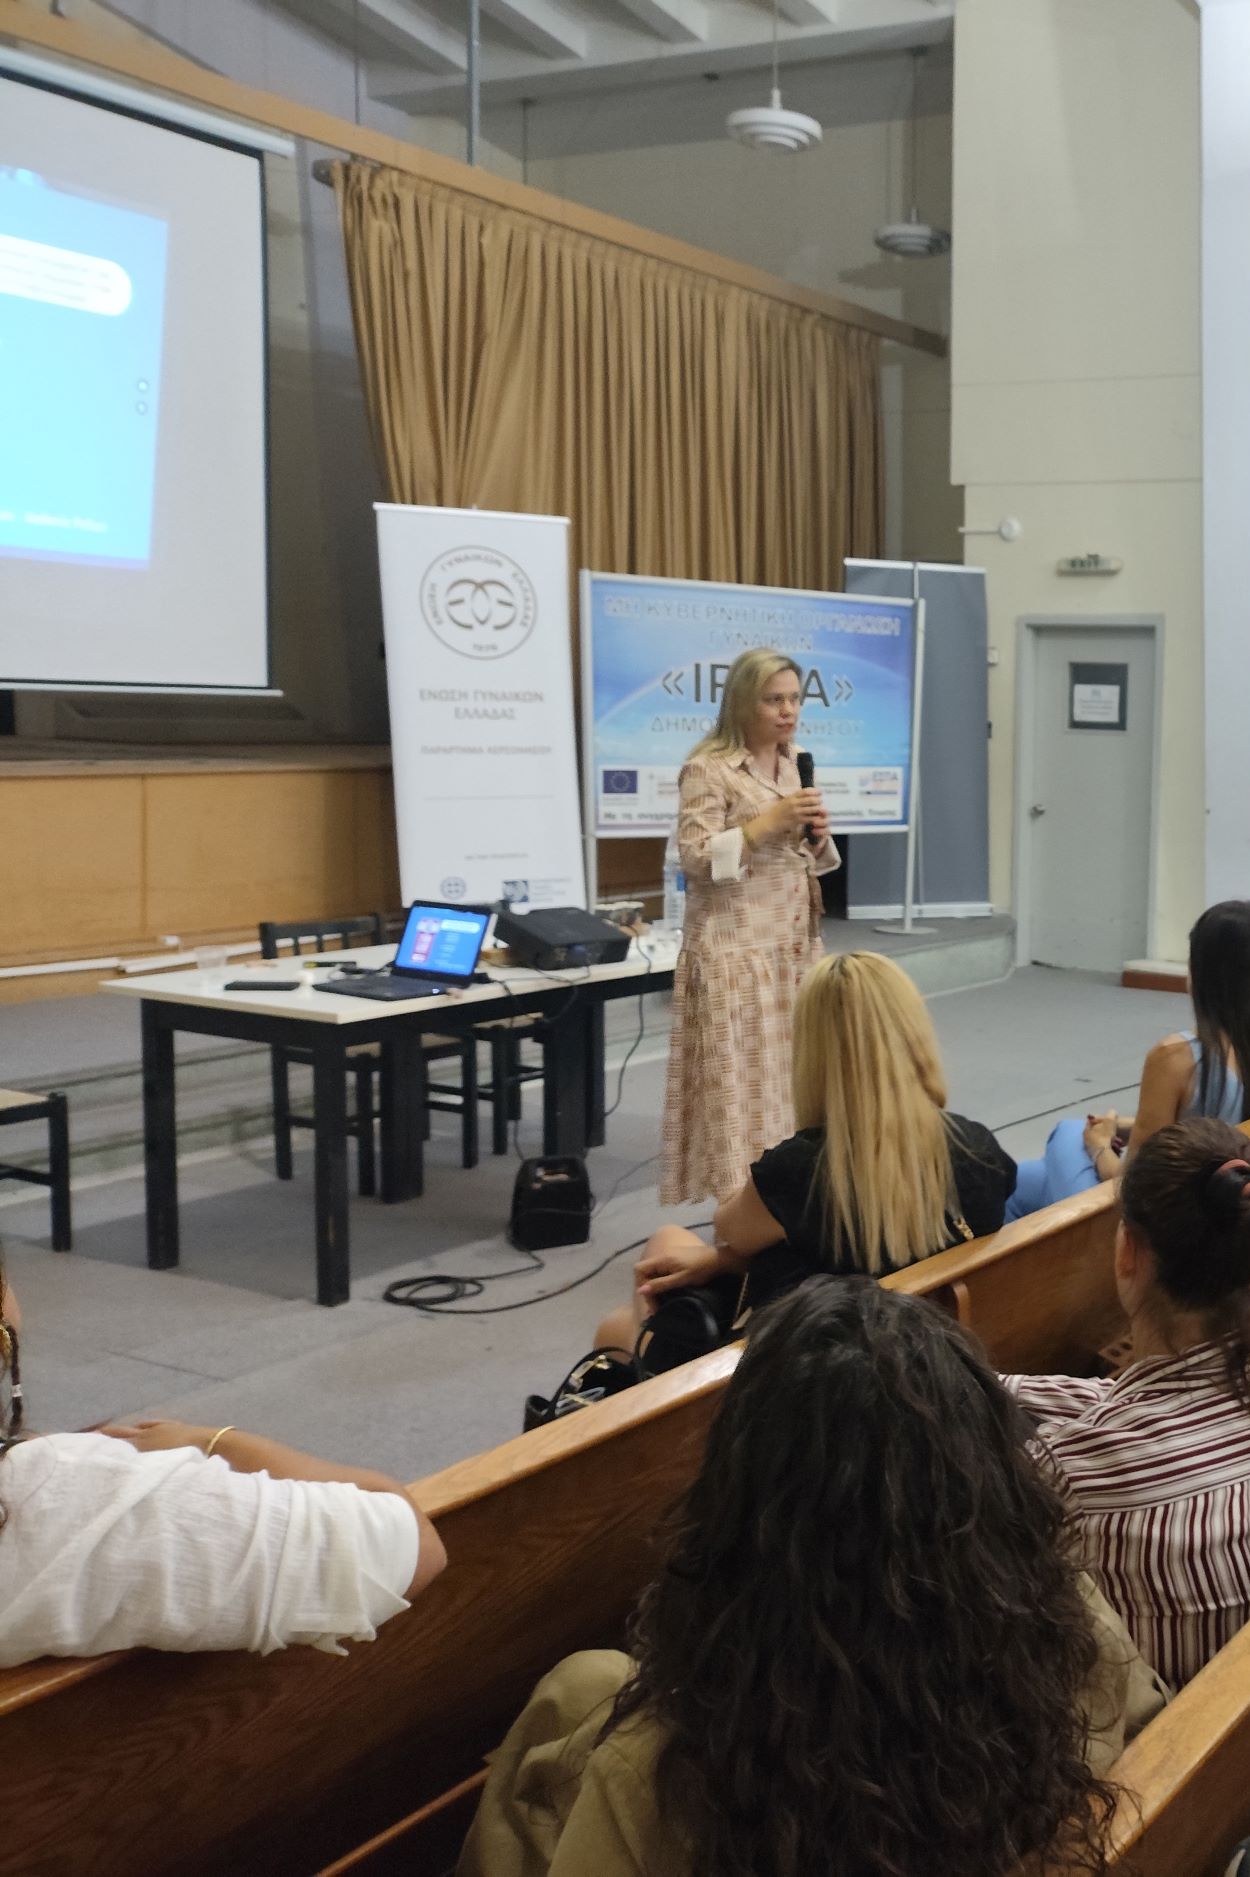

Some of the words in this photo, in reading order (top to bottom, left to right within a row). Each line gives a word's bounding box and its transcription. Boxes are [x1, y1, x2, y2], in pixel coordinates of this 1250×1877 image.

[646, 600, 794, 627] ΚΥΒΕΡΝΗΤΙΚΗ
[709, 629, 813, 650] ΓΥΝΑΙΚΩΝ
[418, 688, 469, 702] ΕΝΩΣΗ
[473, 689, 544, 703] ΓΥΝΑΙΚΩΝ
[454, 706, 516, 720] ΕΛΛΑΔΑΣ
[650, 714, 719, 734] ΔΗΜΟ
